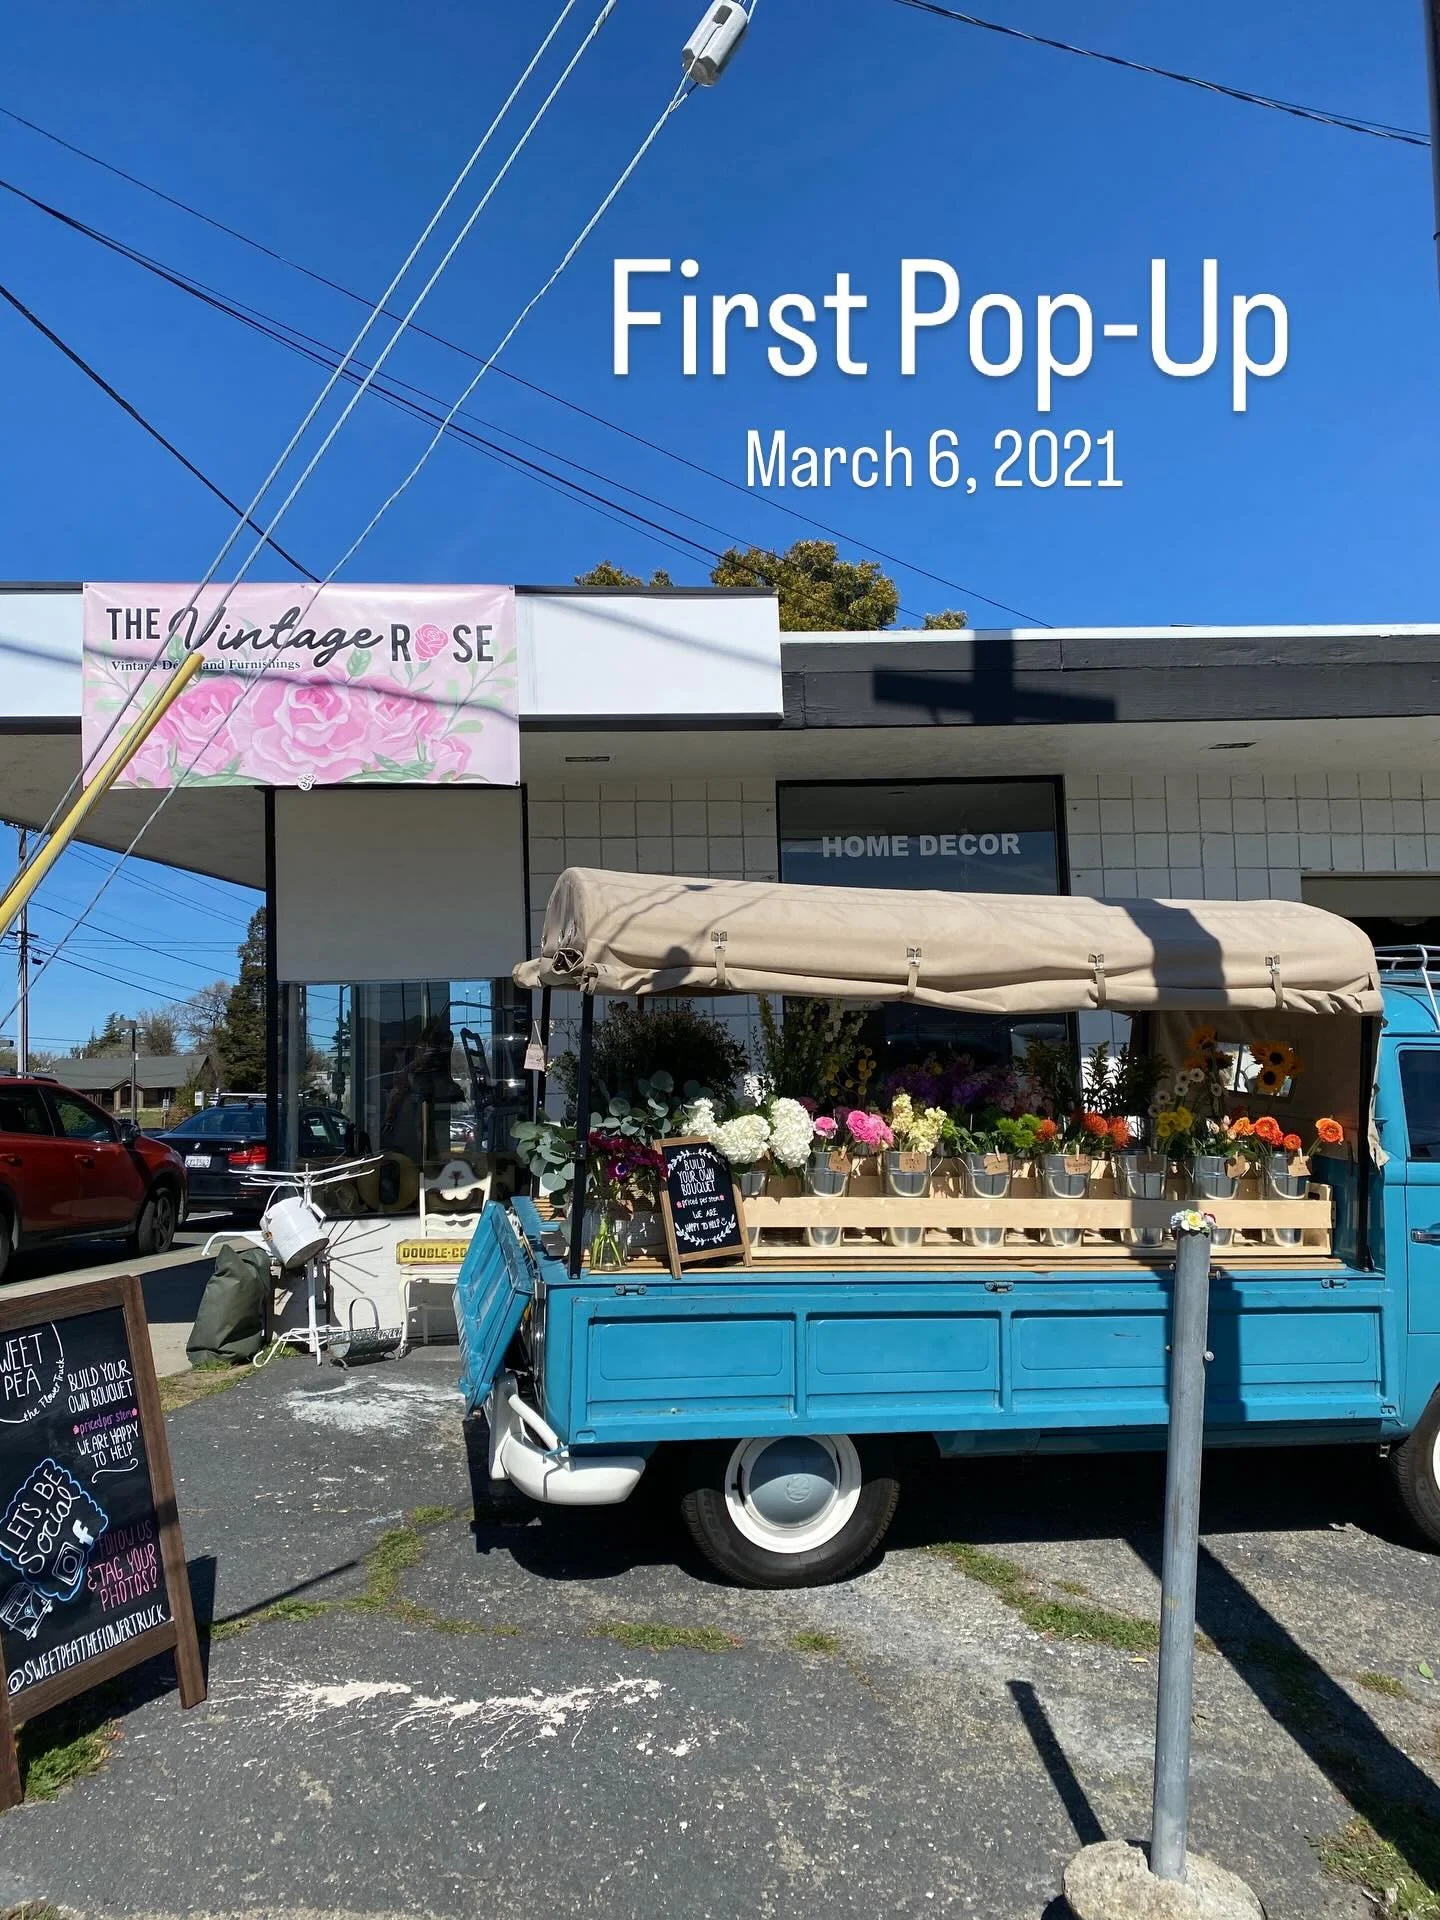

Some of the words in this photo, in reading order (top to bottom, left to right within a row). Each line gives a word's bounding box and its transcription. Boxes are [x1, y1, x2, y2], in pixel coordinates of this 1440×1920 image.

[106, 607, 161, 641] THE
[168, 606, 384, 668] Vintage
[111, 660, 157, 672] Vintage
[202, 659, 225, 670] and
[229, 659, 301, 671] Furnishings
[822, 835, 909, 858] HOME
[919, 833, 1021, 856] DECOR
[677, 1170, 699, 1183] YOUR
[698, 1168, 715, 1181] OWN
[683, 1158, 706, 1171] BUILD
[680, 1180, 715, 1196] BOUQUET
[692, 1210, 703, 1219] WE
[706, 1208, 718, 1217] ARE
[4, 1368, 42, 1401] PEA
[23, 1407, 40, 1421] the
[38, 1382, 60, 1408] Flower
[53, 1357, 65, 1382] Truck
[67, 1366, 99, 1392] BUILD
[99, 1359, 131, 1382] YOUR
[68, 1392, 90, 1413] OWN
[91, 1377, 133, 1407] BOUQUET
[77, 1438, 92, 1456] WE
[91, 1433, 110, 1452] ARE
[109, 1420, 139, 1446] HAPPY
[79, 1413, 103, 1438] priced
[102, 1414, 114, 1430] per
[115, 1409, 132, 1422] stem
[91, 1450, 107, 1468] TO
[110, 1441, 132, 1462] HELP
[33, 1468, 62, 1500] BE
[18, 1486, 80, 1574] Social
[136, 1519, 152, 1542] US
[94, 1556, 123, 1587] TAG
[126, 1543, 157, 1573] YOUR
[99, 1565, 157, 1613] PHOTOS!
[7, 1604, 166, 1695] @SWEETPEATHEFLOWERTRUCK
